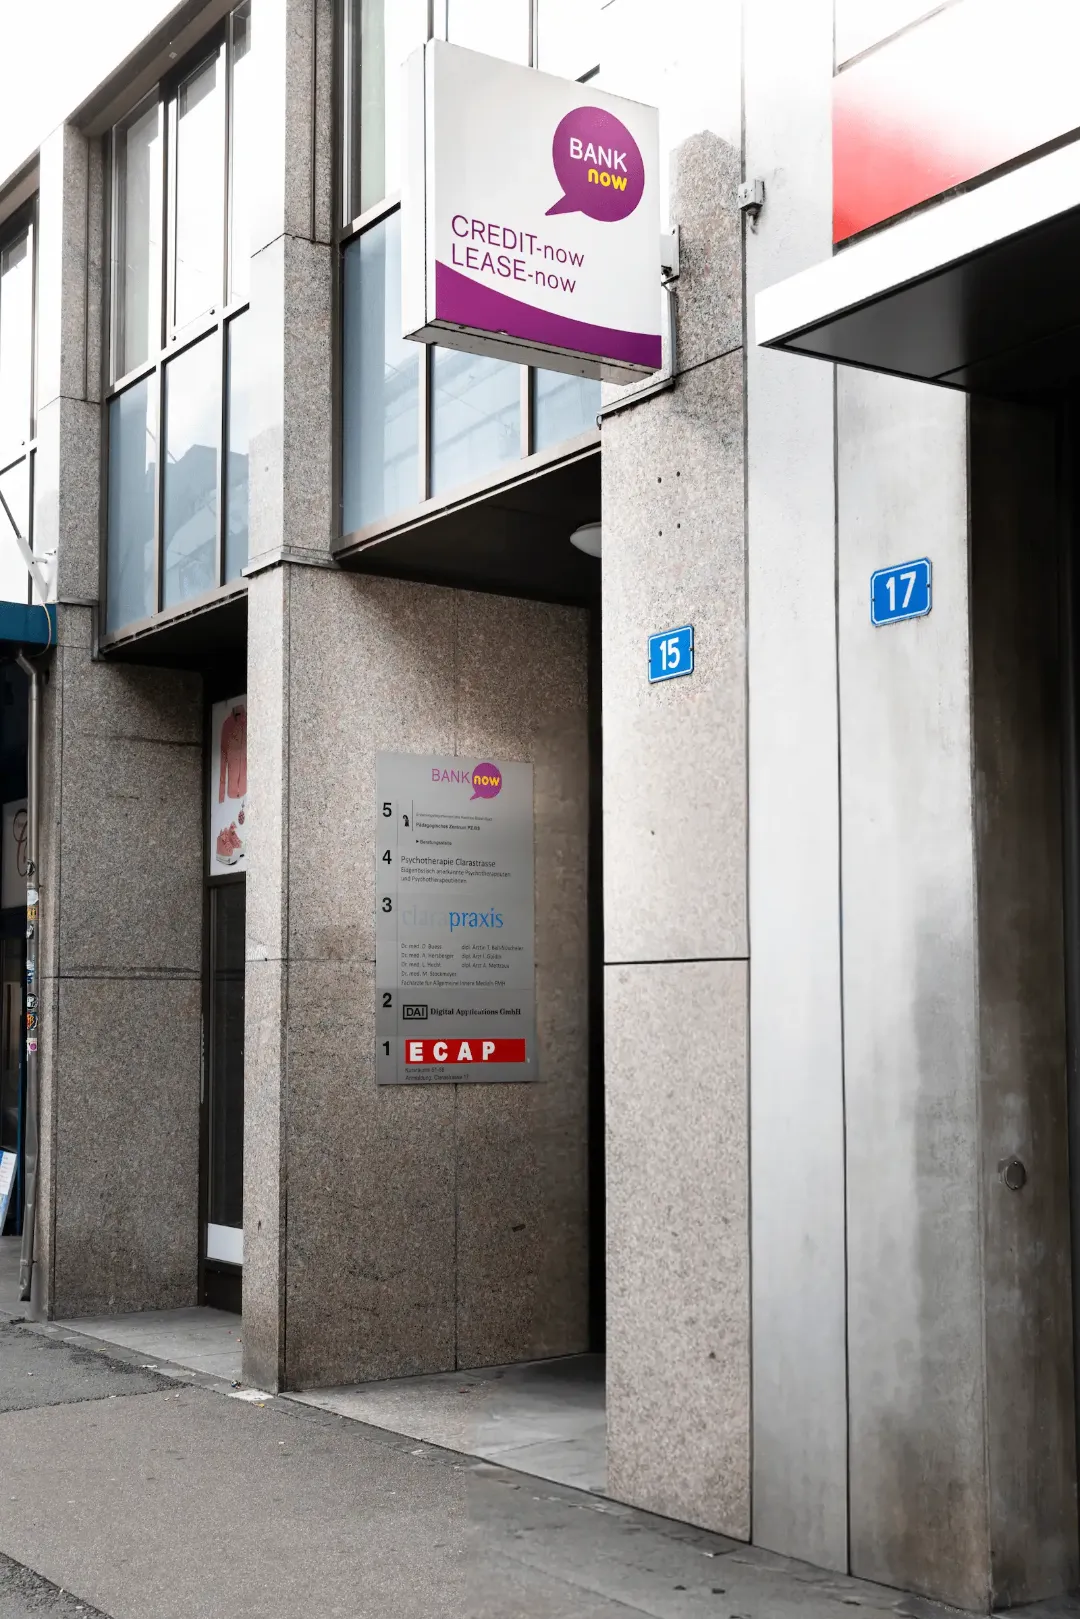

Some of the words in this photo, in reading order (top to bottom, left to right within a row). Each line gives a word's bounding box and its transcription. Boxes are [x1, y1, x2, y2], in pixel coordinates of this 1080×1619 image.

[569, 137, 628, 173] BANK
[587, 168, 628, 192] now
[451, 214, 585, 268] CREDIT-now
[451, 243, 577, 294] LEASE-now
[885, 571, 917, 611] 17
[659, 637, 681, 671] 15
[431, 768, 471, 784] BANK
[473, 775, 500, 786] now
[382, 802, 392, 818] 5
[382, 849, 392, 865] 4
[401, 856, 454, 867] Psychotherapie
[455, 858, 496, 868] Clarastrasse
[382, 897, 393, 913] 3
[382, 992, 392, 1008] 2
[406, 1007, 425, 1017] DAI
[430, 1008, 454, 1016] Digital
[455, 1008, 498, 1017] Applications
[499, 1008, 521, 1016] GmbH
[382, 1041, 390, 1056] 1
[409, 1041, 496, 1062] ECAP
